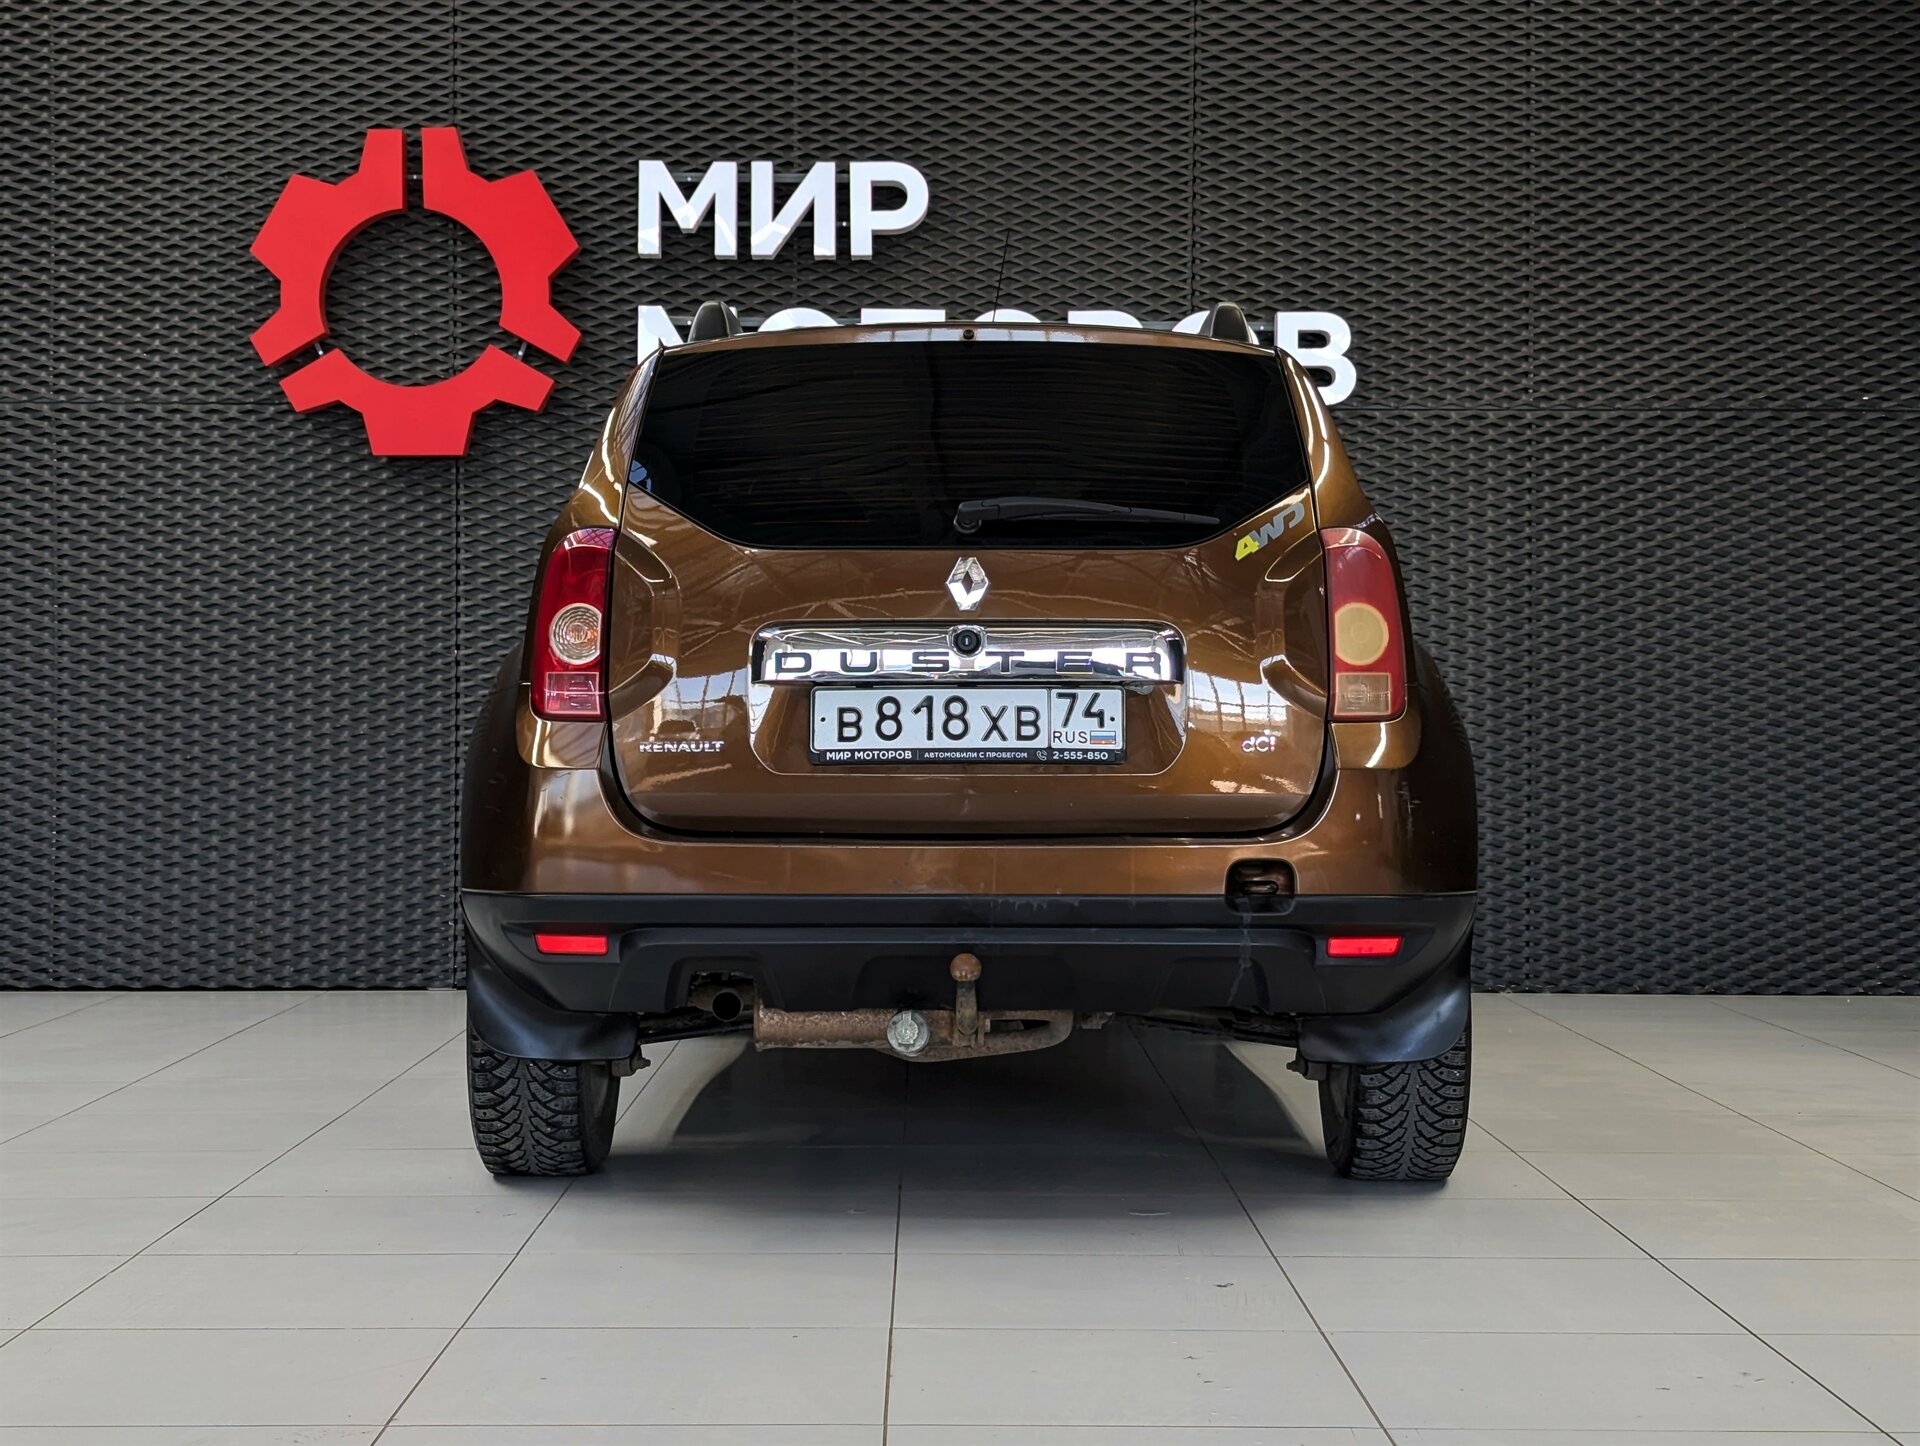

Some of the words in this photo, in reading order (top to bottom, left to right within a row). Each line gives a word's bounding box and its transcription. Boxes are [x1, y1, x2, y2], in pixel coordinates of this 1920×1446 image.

[637, 159, 929, 260] МИР
[1235, 502, 1305, 561] 4WD
[774, 651, 1161, 674] DUSTER
[836, 695, 1042, 743] В818ХВ
[1055, 692, 1106, 729] 74
[639, 740, 725, 753] RENAULT
[1052, 731, 1089, 745] RUS
[826, 751, 852, 761] МИР
[854, 749, 913, 760] МОТОРОВ
[924, 751, 977, 759] АВТОМОБИЛИ
[979, 751, 985, 759] С
[986, 750, 1028, 759] ПРОБЕГОМ
[1052, 751, 1108, 760] 2-555-850
